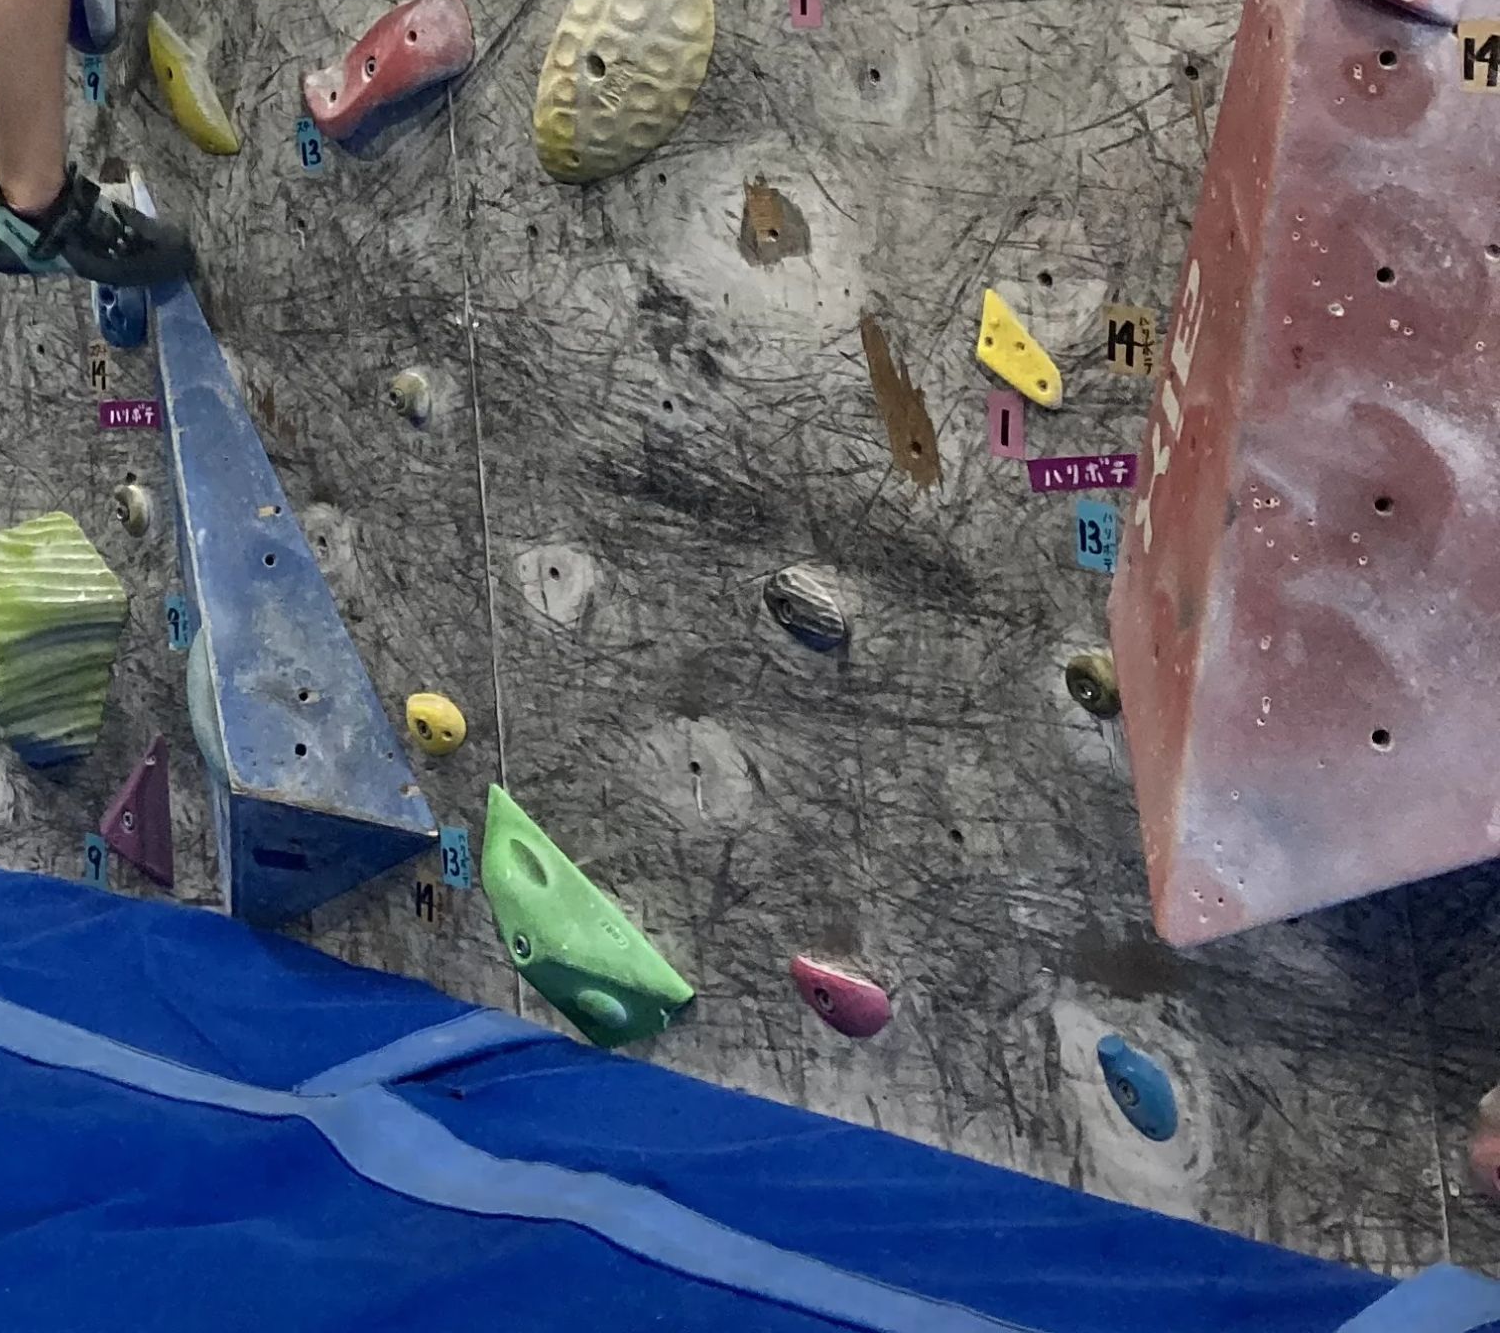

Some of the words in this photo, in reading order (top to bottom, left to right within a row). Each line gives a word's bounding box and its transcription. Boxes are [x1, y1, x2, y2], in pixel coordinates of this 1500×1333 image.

[86, 73, 99, 101] 9
[301, 138, 321, 167] 13
[1108, 319, 1146, 368] 14
[91, 360, 106, 390] 14
[109, 402, 156, 424] ハリボテ
[1001, 409, 1009, 446] 1
[1044, 459, 1129, 488] ハリボテ
[1079, 519, 1102, 555] 13
[167, 608, 180, 641] 9
[88, 845, 100, 880] 9
[443, 849, 460, 877] 13
[415, 881, 433, 923] 14
